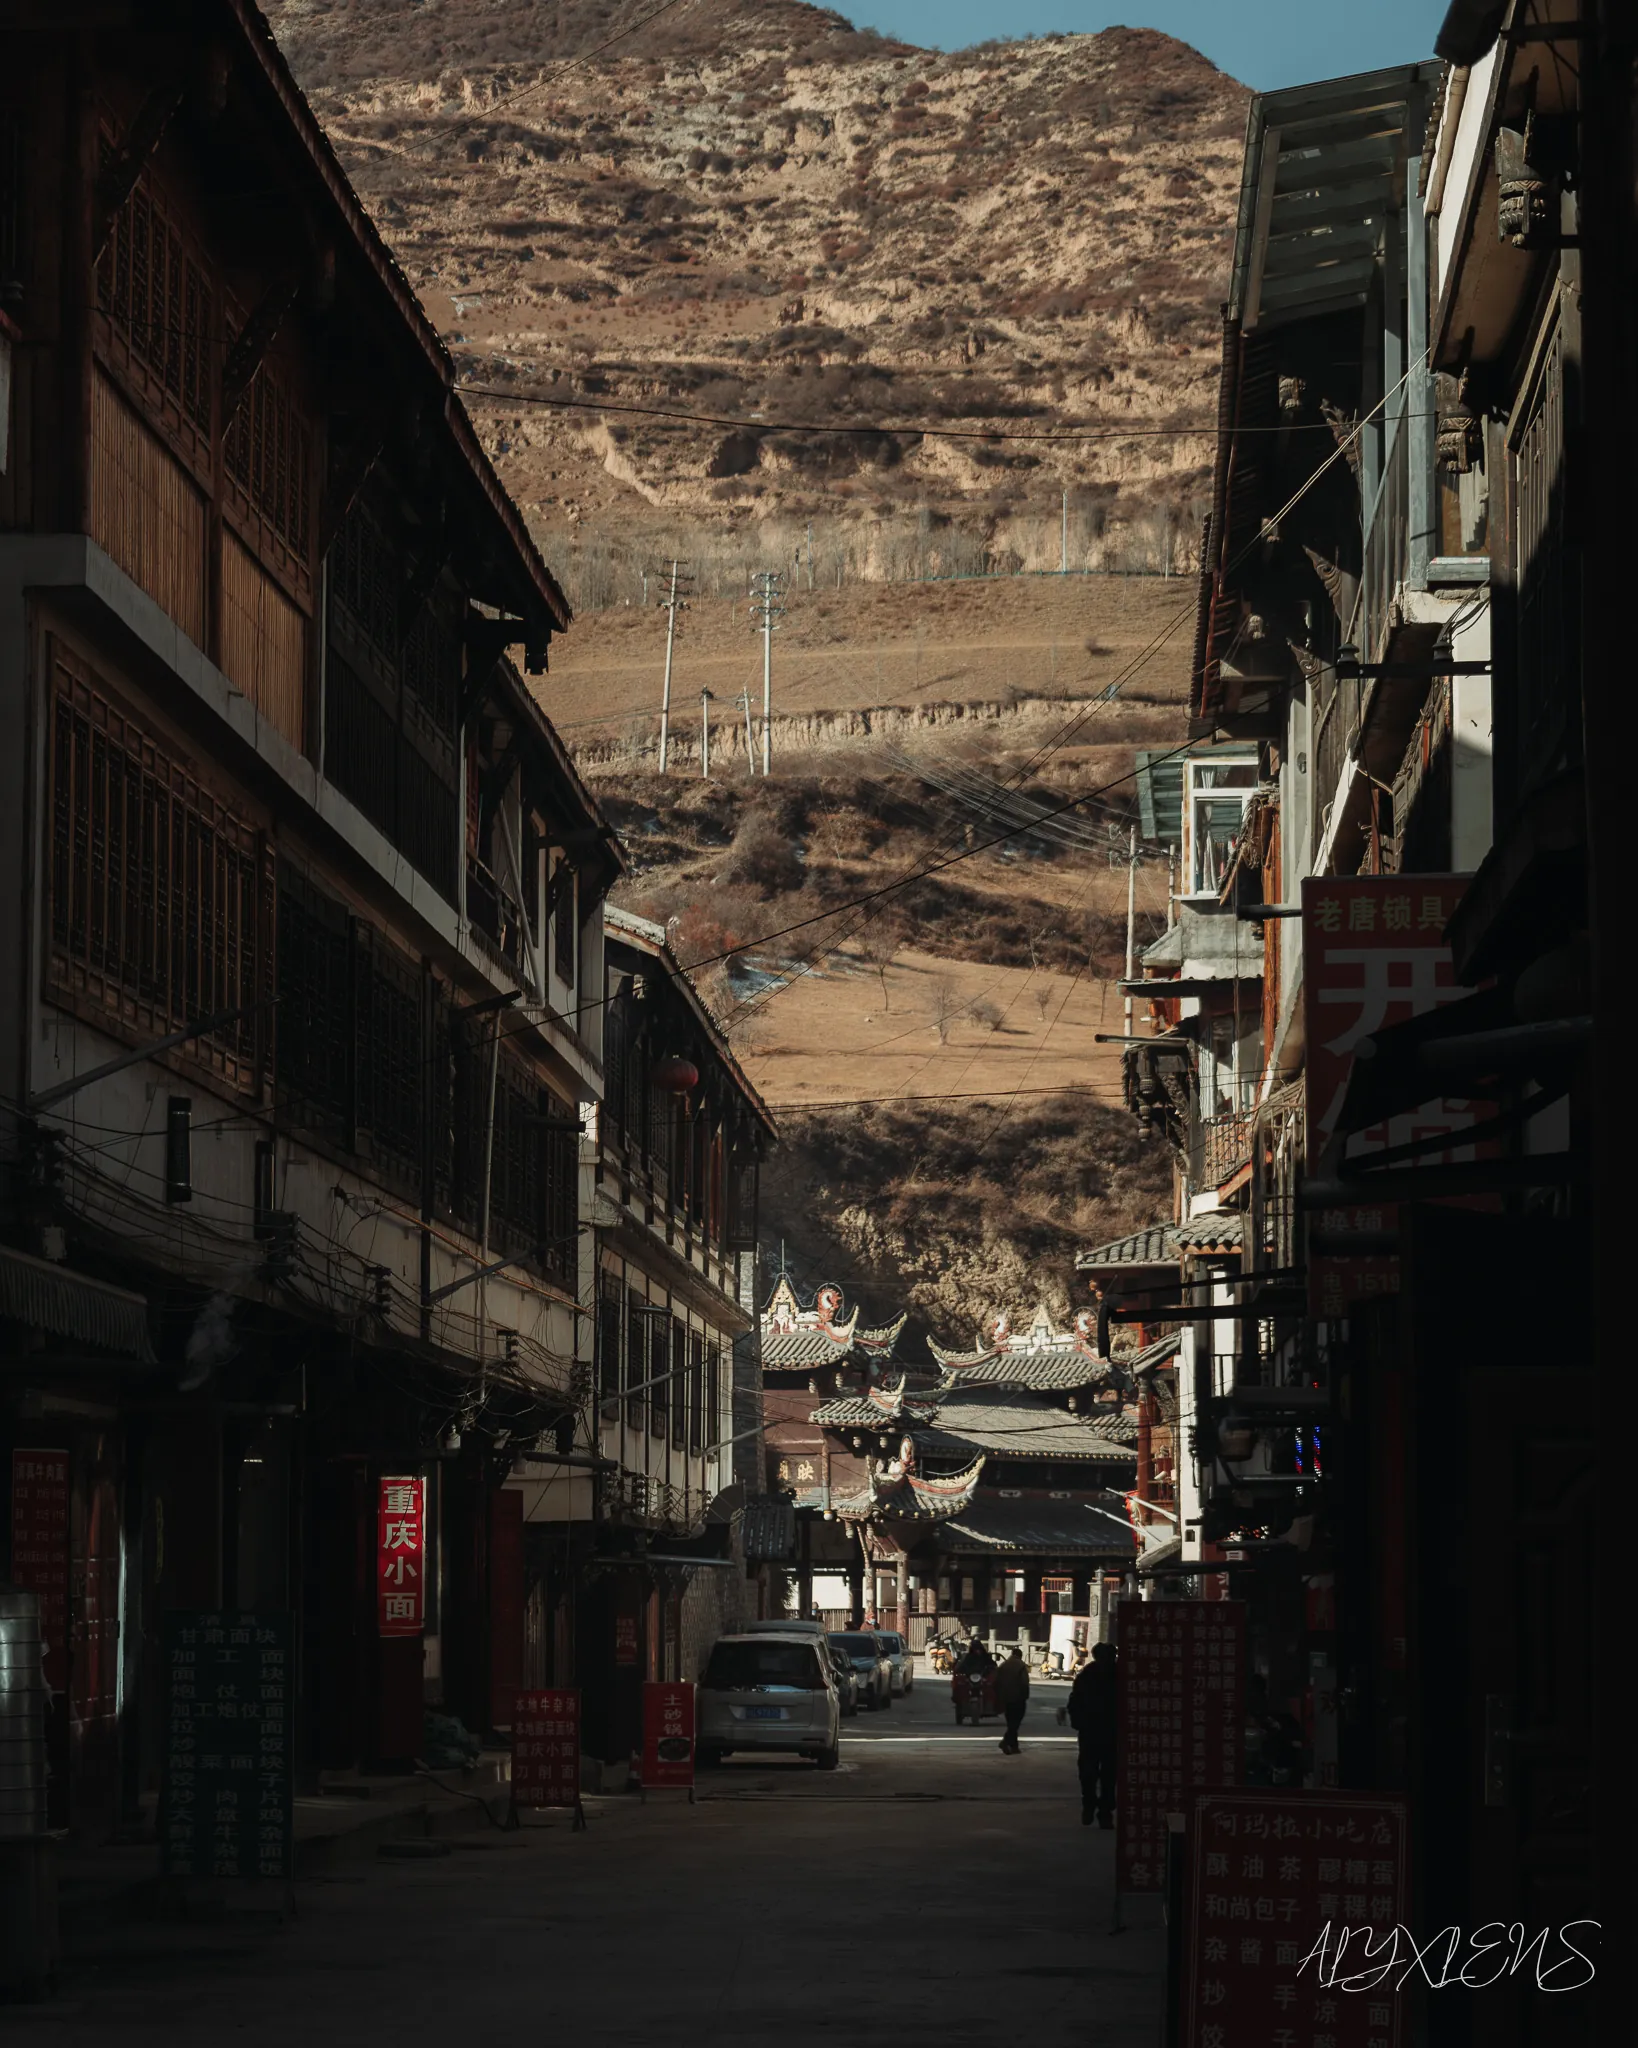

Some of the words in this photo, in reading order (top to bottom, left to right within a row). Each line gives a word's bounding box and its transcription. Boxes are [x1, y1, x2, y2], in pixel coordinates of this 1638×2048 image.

[1313, 894, 1461, 932] 老唐锁具
[1321, 1271, 1344, 1316] 电话
[382, 1485, 418, 1621] 重庆小面
[178, 1628, 278, 1644] 甘肃面块
[171, 1648, 285, 1664] 加工面
[171, 1666, 285, 1681] 面块
[171, 1684, 285, 1699] 炮仗面
[516, 1696, 575, 1714] 本地牛杂汤
[171, 1701, 285, 1718] 加工炮仗面
[663, 1694, 683, 1735] 土砂锅
[170, 1719, 285, 1734] 拉面
[517, 1742, 575, 1757] 重庆小面
[516, 1764, 575, 1780] 刀削面
[1211, 1810, 1392, 1845] 阿玛拉小吃店
[1206, 1852, 1301, 1881] 酥油茶
[1317, 1857, 1395, 1885] 醪糟蛋
[1205, 1893, 1301, 1922] 和尚包子
[1316, 1893, 1394, 1921] 青稞饼
[1204, 1936, 1299, 1966] 杂酱面
[1201, 1979, 1298, 2011] 抄手
[1314, 1998, 1391, 2027] 凉面
